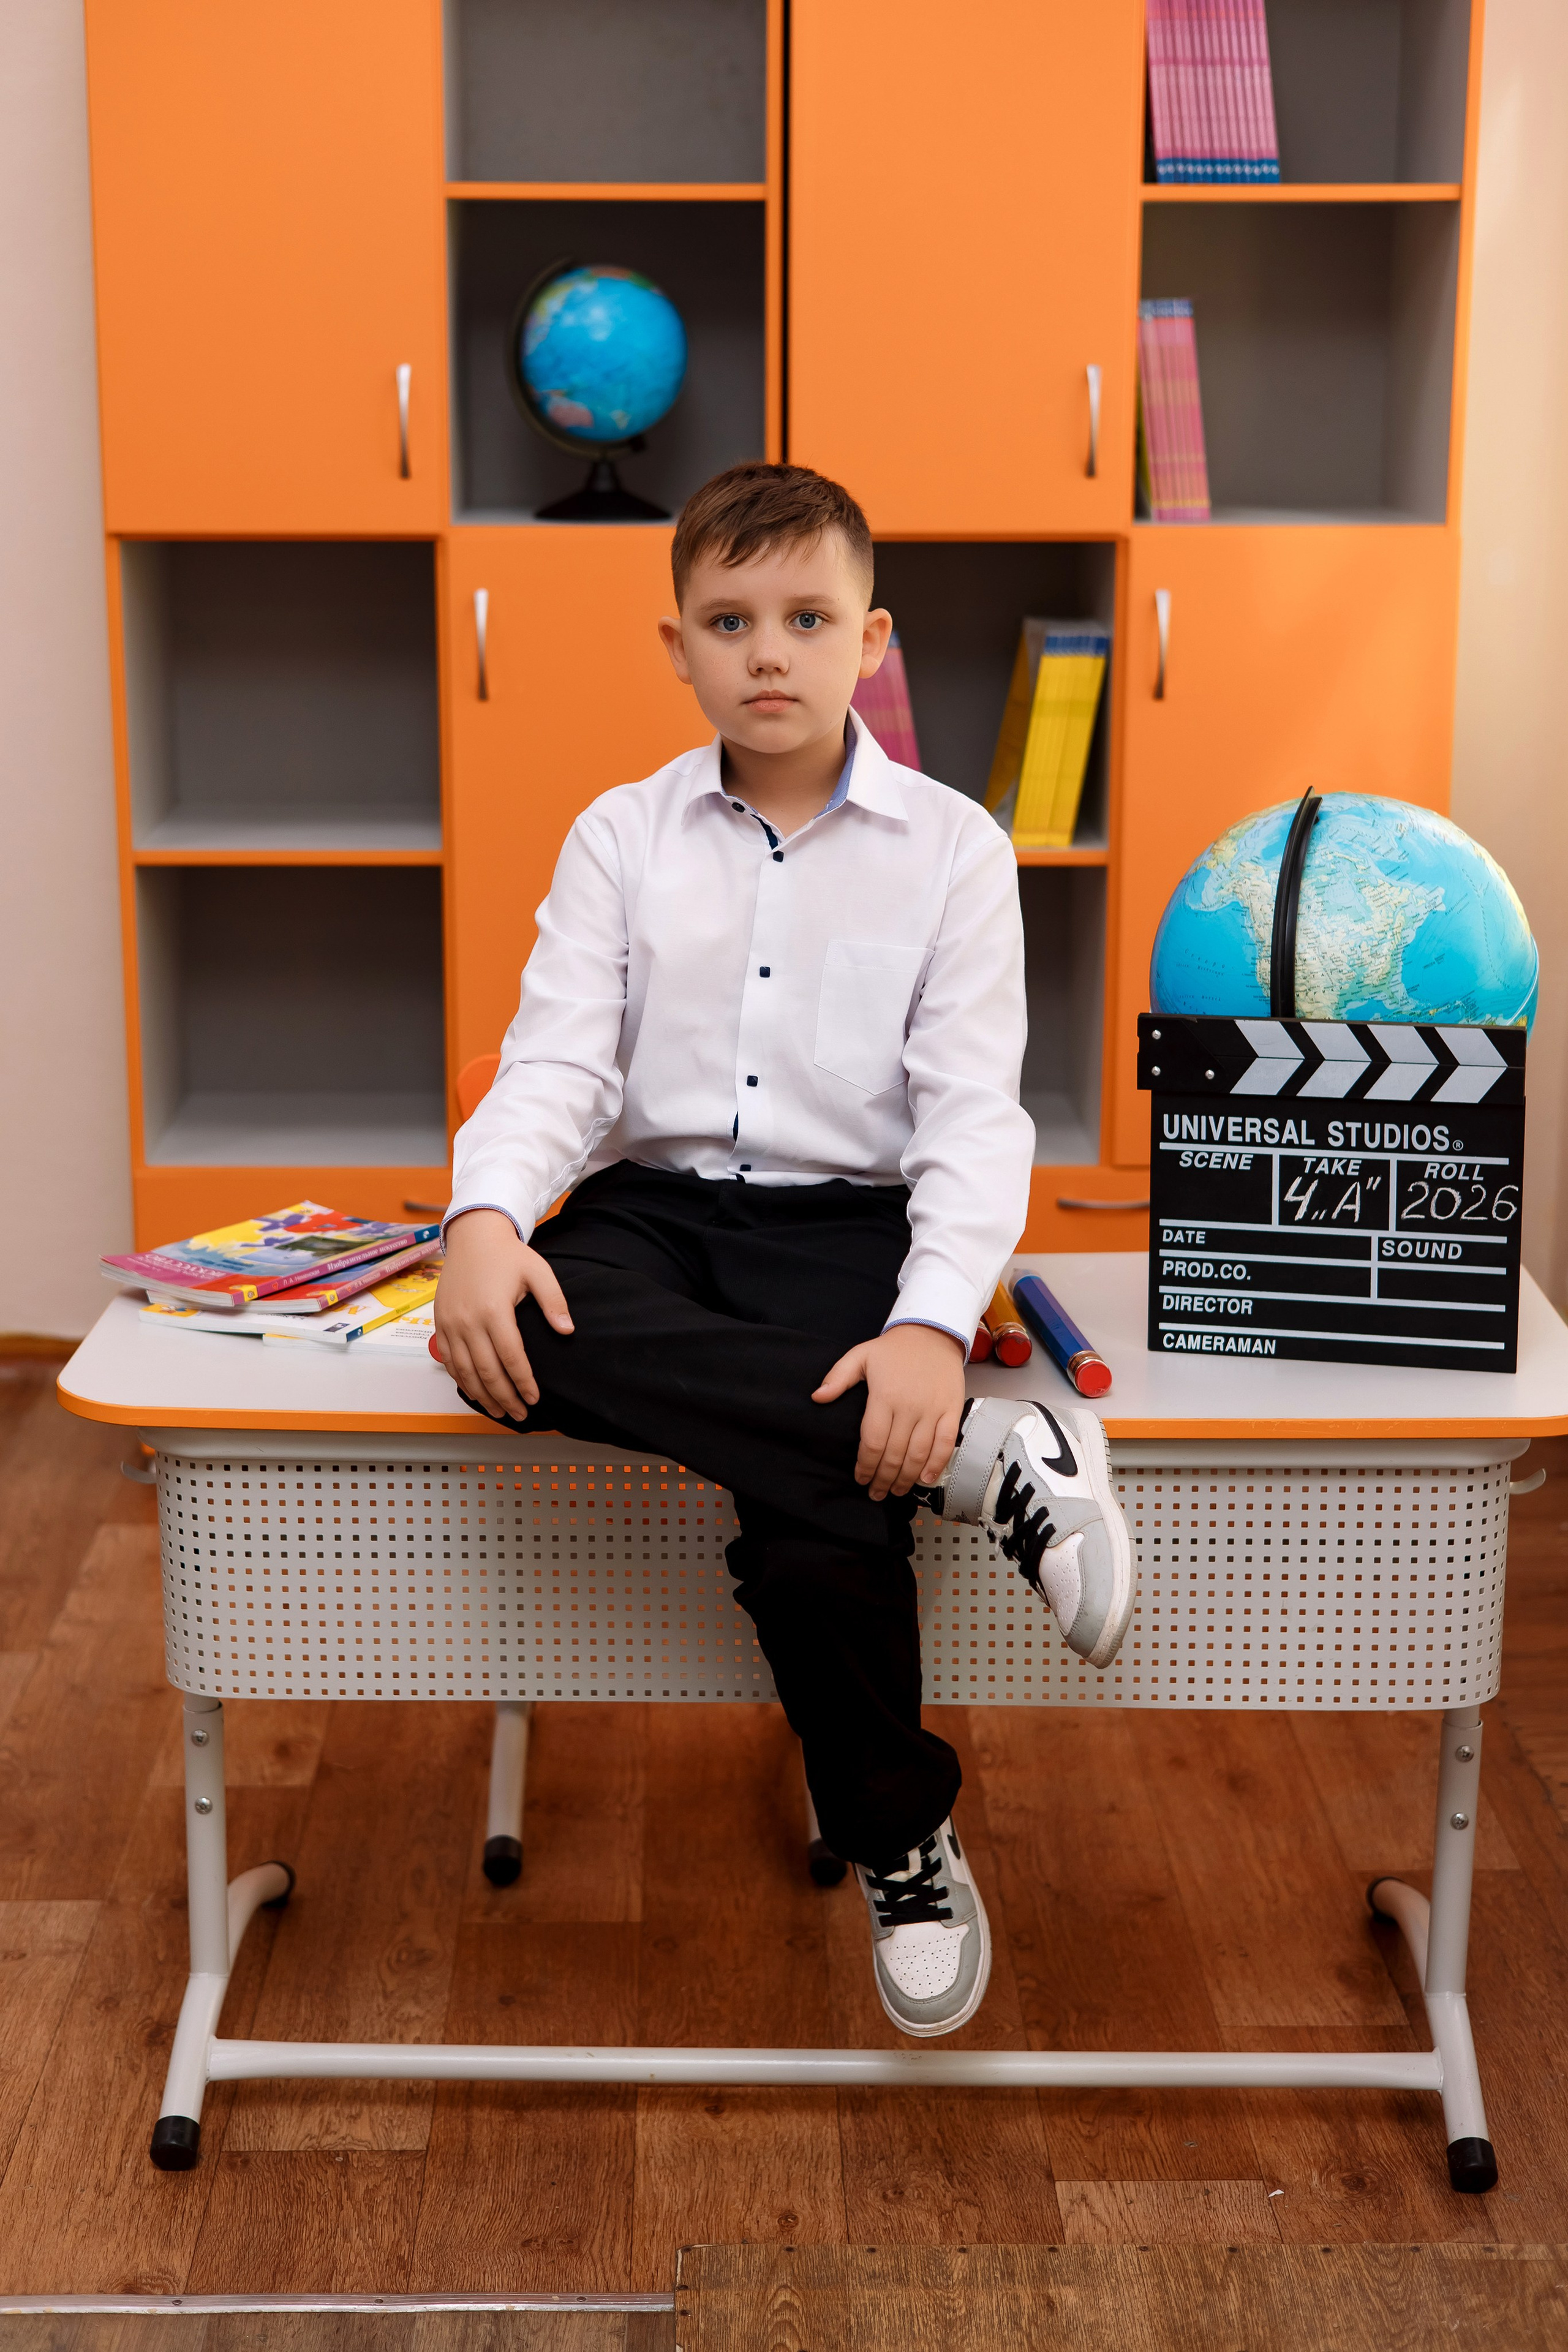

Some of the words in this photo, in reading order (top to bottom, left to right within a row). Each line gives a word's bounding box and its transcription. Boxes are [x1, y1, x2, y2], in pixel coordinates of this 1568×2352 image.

[1163, 1114, 1315, 1145] UNIVERSAL
[1179, 1151, 1254, 1170] SCENE
[1303, 1157, 1362, 1176] TAKE
[1423, 1162, 1484, 1181] ROLL
[1401, 1181, 1519, 1221] 2026
[379, 1239, 407, 1253] искусство
[1163, 1229, 1206, 1244] DATE
[1381, 1240, 1462, 1259] SOUND
[1163, 1260, 1251, 1280] PROD.CO.
[1163, 1294, 1253, 1314] DIRECTOR
[1163, 1333, 1276, 1355] CAMERAMAN
